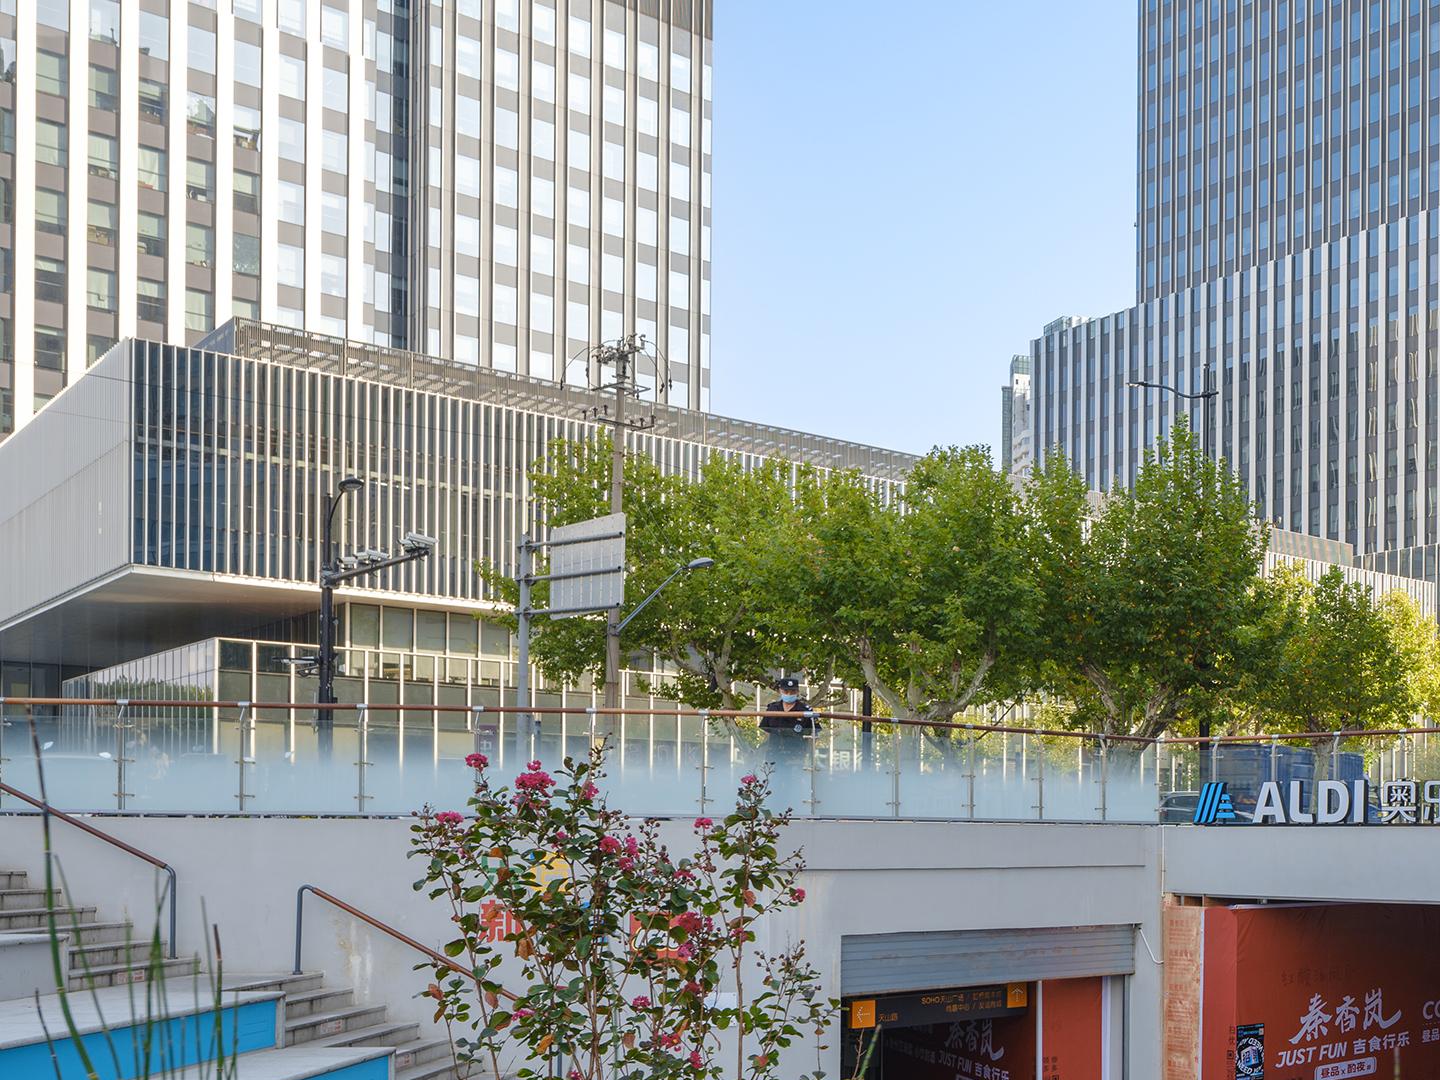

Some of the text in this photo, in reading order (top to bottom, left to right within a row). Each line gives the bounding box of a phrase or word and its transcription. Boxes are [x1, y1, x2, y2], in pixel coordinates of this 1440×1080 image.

[1252, 779, 1369, 824] ALDI
[937, 1049, 957, 1068] JUST
[957, 1056, 972, 1074] FUN
[1275, 1046, 1317, 1069] JUST
[1318, 1041, 1348, 1061] FUN
[1352, 1031, 1411, 1056] 吉食行乐
